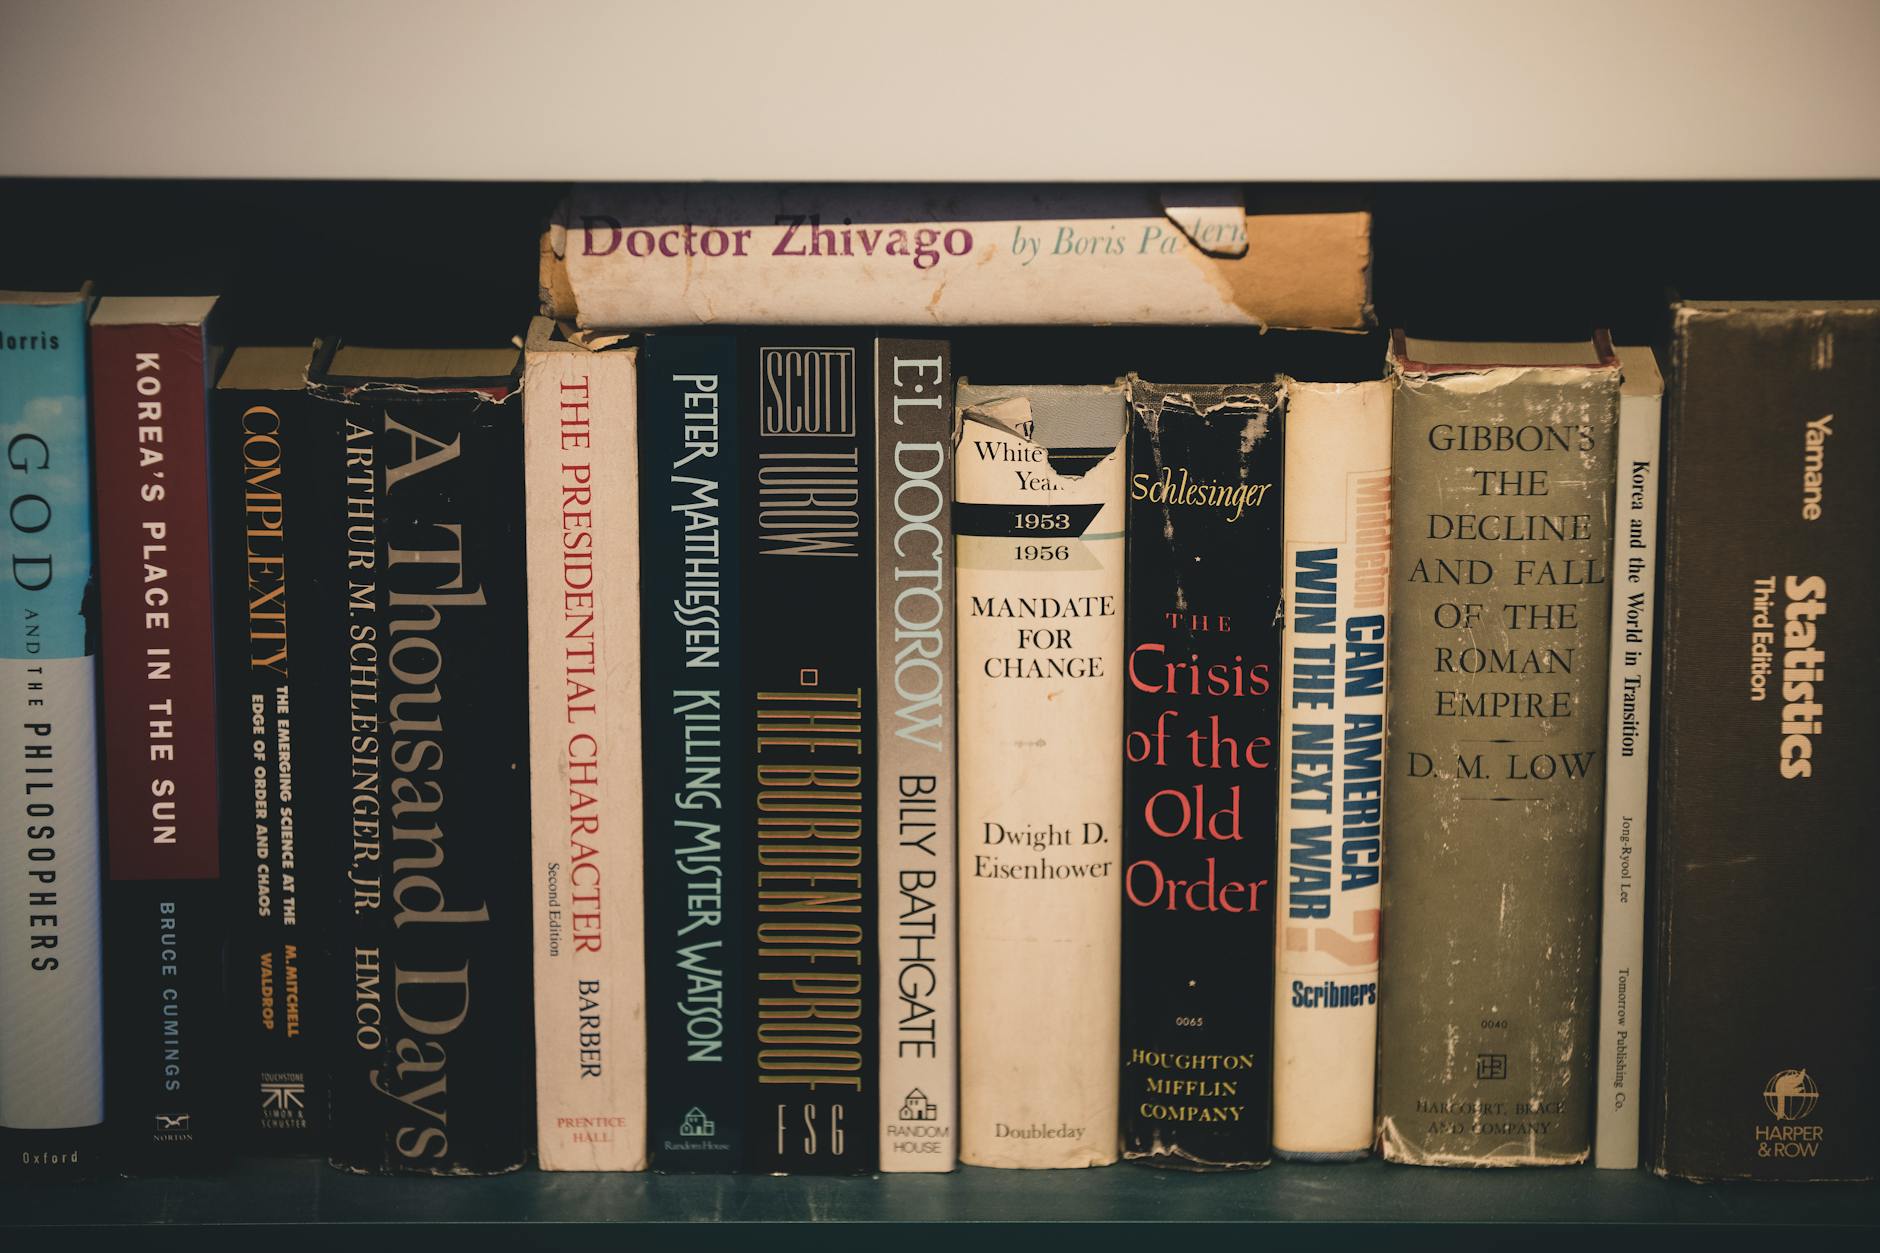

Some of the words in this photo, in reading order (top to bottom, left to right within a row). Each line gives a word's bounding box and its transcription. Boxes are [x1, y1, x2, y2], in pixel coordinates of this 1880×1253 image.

[579, 214, 752, 257] Doctor
[771, 213, 974, 271] Zhivago
[1012, 225, 1041, 266] by
[1051, 225, 1126, 256] Boris
[0, 331, 60, 351] orris
[559, 376, 590, 451] THE
[766, 350, 851, 434] SCOTT
[135, 352, 166, 503] KOREA'S
[673, 374, 719, 469] PETER
[1428, 424, 1595, 452] GIBBON'S
[384, 409, 460, 496] A
[974, 441, 1043, 463] White
[1802, 413, 1834, 522] Yamane
[345, 418, 375, 570] ARTHUR
[757, 447, 860, 557] TUROW
[1131, 466, 1272, 523] Schlesinger
[1473, 470, 1550, 496] THE
[1631, 461, 1650, 510] Korea
[8, 433, 53, 592] GOD
[1014, 513, 1071, 530] 1953
[1426, 514, 1593, 542] DECLINE
[1629, 518, 1647, 549] and
[242, 404, 288, 678] COMPLEXITY
[1014, 545, 1070, 561] 1956
[142, 521, 170, 630] PLACE
[561, 463, 597, 724] PRESIDENTIAL
[893, 441, 944, 752] DOCTOROW
[1294, 547, 1338, 634] WIN
[1407, 557, 1494, 584] AND
[1513, 559, 1605, 587] FALL
[1628, 556, 1646, 584] the
[349, 580, 376, 617] M.
[970, 596, 1116, 618] MANDATE
[1165, 612, 1232, 632] THE
[1434, 602, 1484, 630] OF
[1503, 603, 1578, 630] THE
[1626, 592, 1645, 644] World
[1751, 575, 1776, 629] Third
[24, 608, 41, 655] AND
[1018, 628, 1072, 649] FOR
[1345, 614, 1385, 698] CAN
[1624, 650, 1642, 666] in
[27, 667, 43, 707] THE
[147, 648, 171, 681] IN
[984, 657, 1105, 678] CHANGE
[1128, 643, 1271, 697] Crisis
[1292, 642, 1336, 710] THE
[1433, 647, 1576, 674] ROMAN
[1750, 631, 1774, 703] Edition
[1780, 574, 1827, 780] Statistics
[252, 694, 265, 736] EDGE
[276, 685, 290, 715] THE
[388, 523, 487, 929] Thousand
[756, 687, 862, 755] THE
[1435, 691, 1572, 719] EMPIRE
[1621, 675, 1642, 758] Transition
[148, 698, 174, 762] THE
[253, 740, 266, 762] OF
[349, 625, 380, 870] SCHLESINGER,
[1126, 710, 1179, 767] of
[1186, 715, 1272, 770] the
[277, 719, 292, 804] EMERGING
[1290, 723, 1334, 816] NEXT
[1407, 751, 1438, 778] D.
[1456, 753, 1490, 780] M.
[1505, 750, 1597, 780] LOW
[150, 778, 177, 846] SUN
[254, 766, 268, 820] ORDER
[898, 775, 937, 857] BILLY
[1144, 784, 1243, 841] Old
[1341, 713, 1383, 892] AMERICA
[23, 722, 59, 973] PHILOSOPHERS
[256, 823, 269, 860] AND
[280, 807, 294, 870] SCIENCE
[568, 733, 602, 955] CHARACTER
[756, 764, 863, 913] BURDEN
[984, 822, 1073, 852] Dwight
[1081, 823, 1108, 845] D.
[1619, 815, 1633, 882] Jong-Ryool
[257, 863, 271, 917] CHAOS
[282, 874, 295, 893] AT
[348, 870, 381, 915] JR.
[548, 862, 561, 907] Second
[674, 820, 722, 937] MISTER
[973, 855, 1113, 879] Eisenhower
[1125, 857, 1268, 913] Order
[1289, 825, 1332, 920] WAR
[283, 897, 296, 926] THE
[1619, 884, 1631, 904] Lee
[160, 902, 177, 977] BRUCE
[549, 911, 562, 957] Edition
[756, 923, 863, 966] OF
[898, 870, 937, 1059] BATHGATE
[260, 952, 275, 1031] WALDROP
[354, 948, 382, 1051] HMCO
[675, 940, 722, 1063] WATSON
[1291, 979, 1377, 1008] Scribners
[1617, 967, 1630, 1027] Tomorrow
[162, 989, 181, 1092] CUMINGS
[578, 979, 602, 1080] BARBER
[757, 972, 863, 1093] PROOF
[1176, 1016, 1203, 1027] 0065
[1480, 1020, 1508, 1029] 0040
[370, 959, 469, 1160] Days
[1126, 1048, 1255, 1070] HOUGHTON
[1613, 1030, 1628, 1089] Publishing
[1140, 1102, 1245, 1122] COMPANY
[1146, 1077, 1238, 1097] MIFFLIN
[1515, 1103, 1565, 1116] BRACE
[1614, 1091, 1626, 1113] Co.
[153, 1134, 193, 1142] NORTON
[557, 1117, 626, 1129] PRENTICE
[573, 1131, 610, 1143] HALL
[887, 1125, 949, 1138] RANDOM
[893, 1141, 942, 1154] HOUSE
[995, 1123, 1086, 1141] Doubleday
[1428, 1120, 1464, 1134] AND
[1471, 1121, 1551, 1136] COMPANY
[1755, 1125, 1824, 1142] HARPER
[22, 1151, 79, 1165] Oxford
